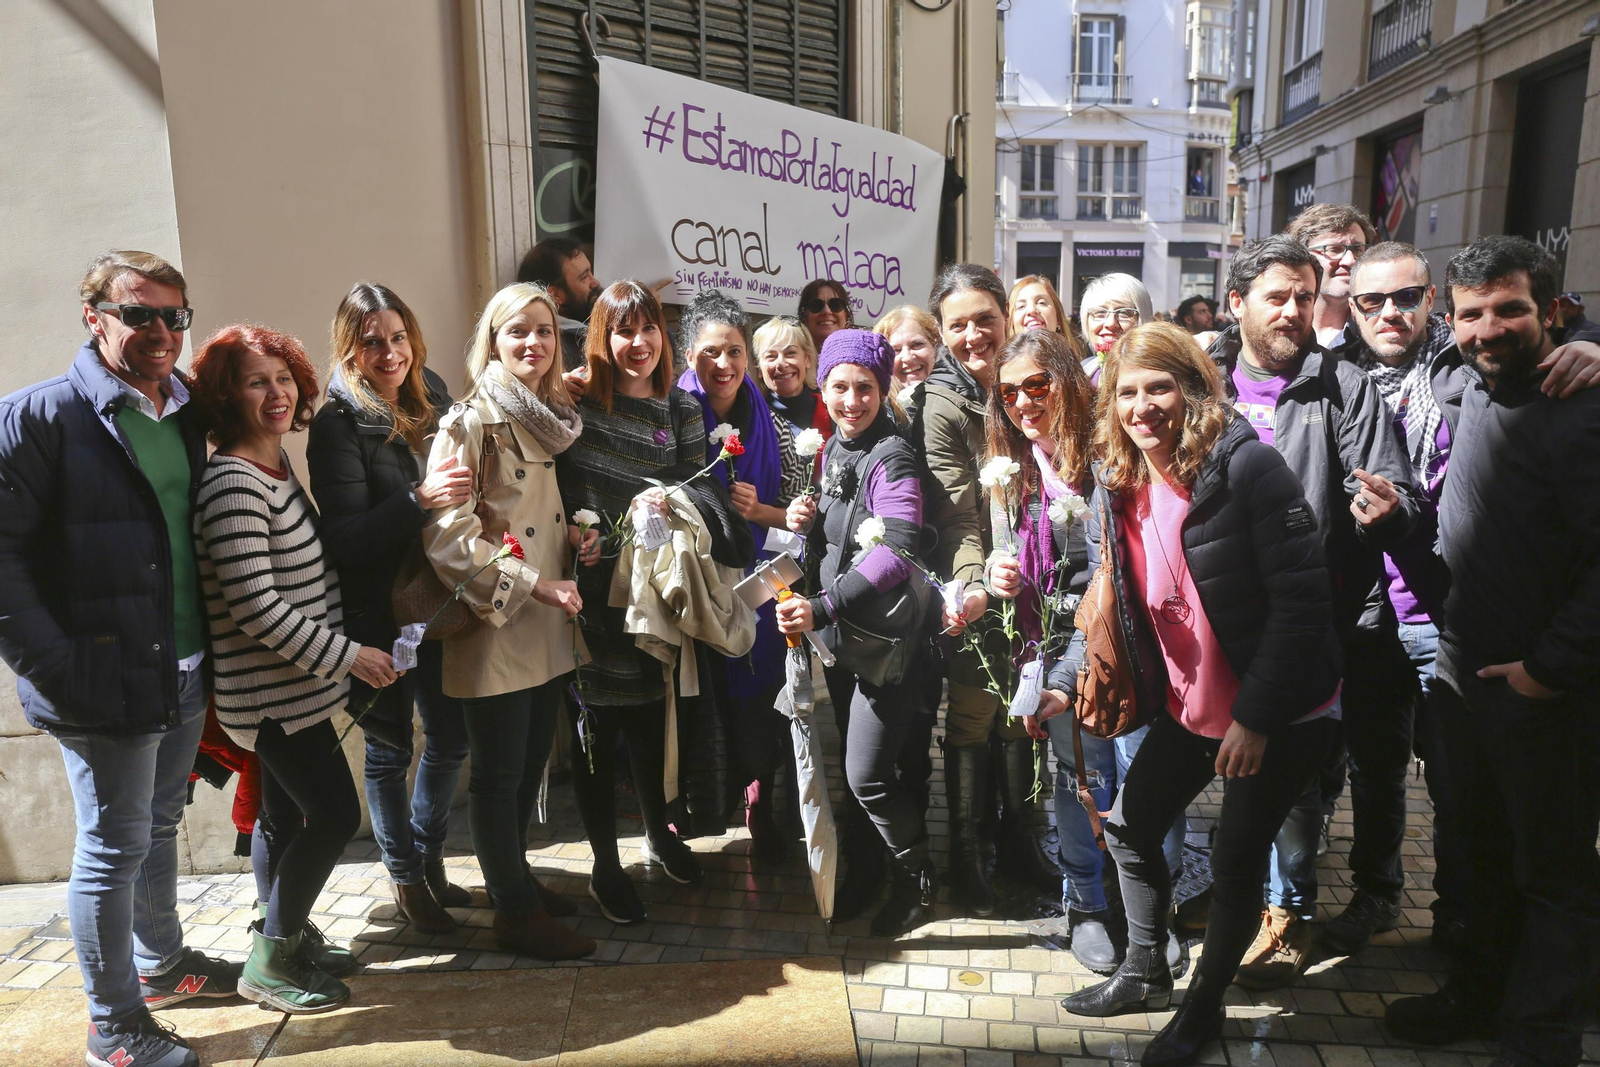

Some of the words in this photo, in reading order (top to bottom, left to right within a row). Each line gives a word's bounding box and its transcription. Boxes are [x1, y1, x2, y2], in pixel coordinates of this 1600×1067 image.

[671, 202, 781, 276] canal
[797, 223, 905, 318] málaga
[1116, 248, 1141, 257] SECRET
[747, 279, 759, 291] NO
[760, 282, 772, 296] HAY
